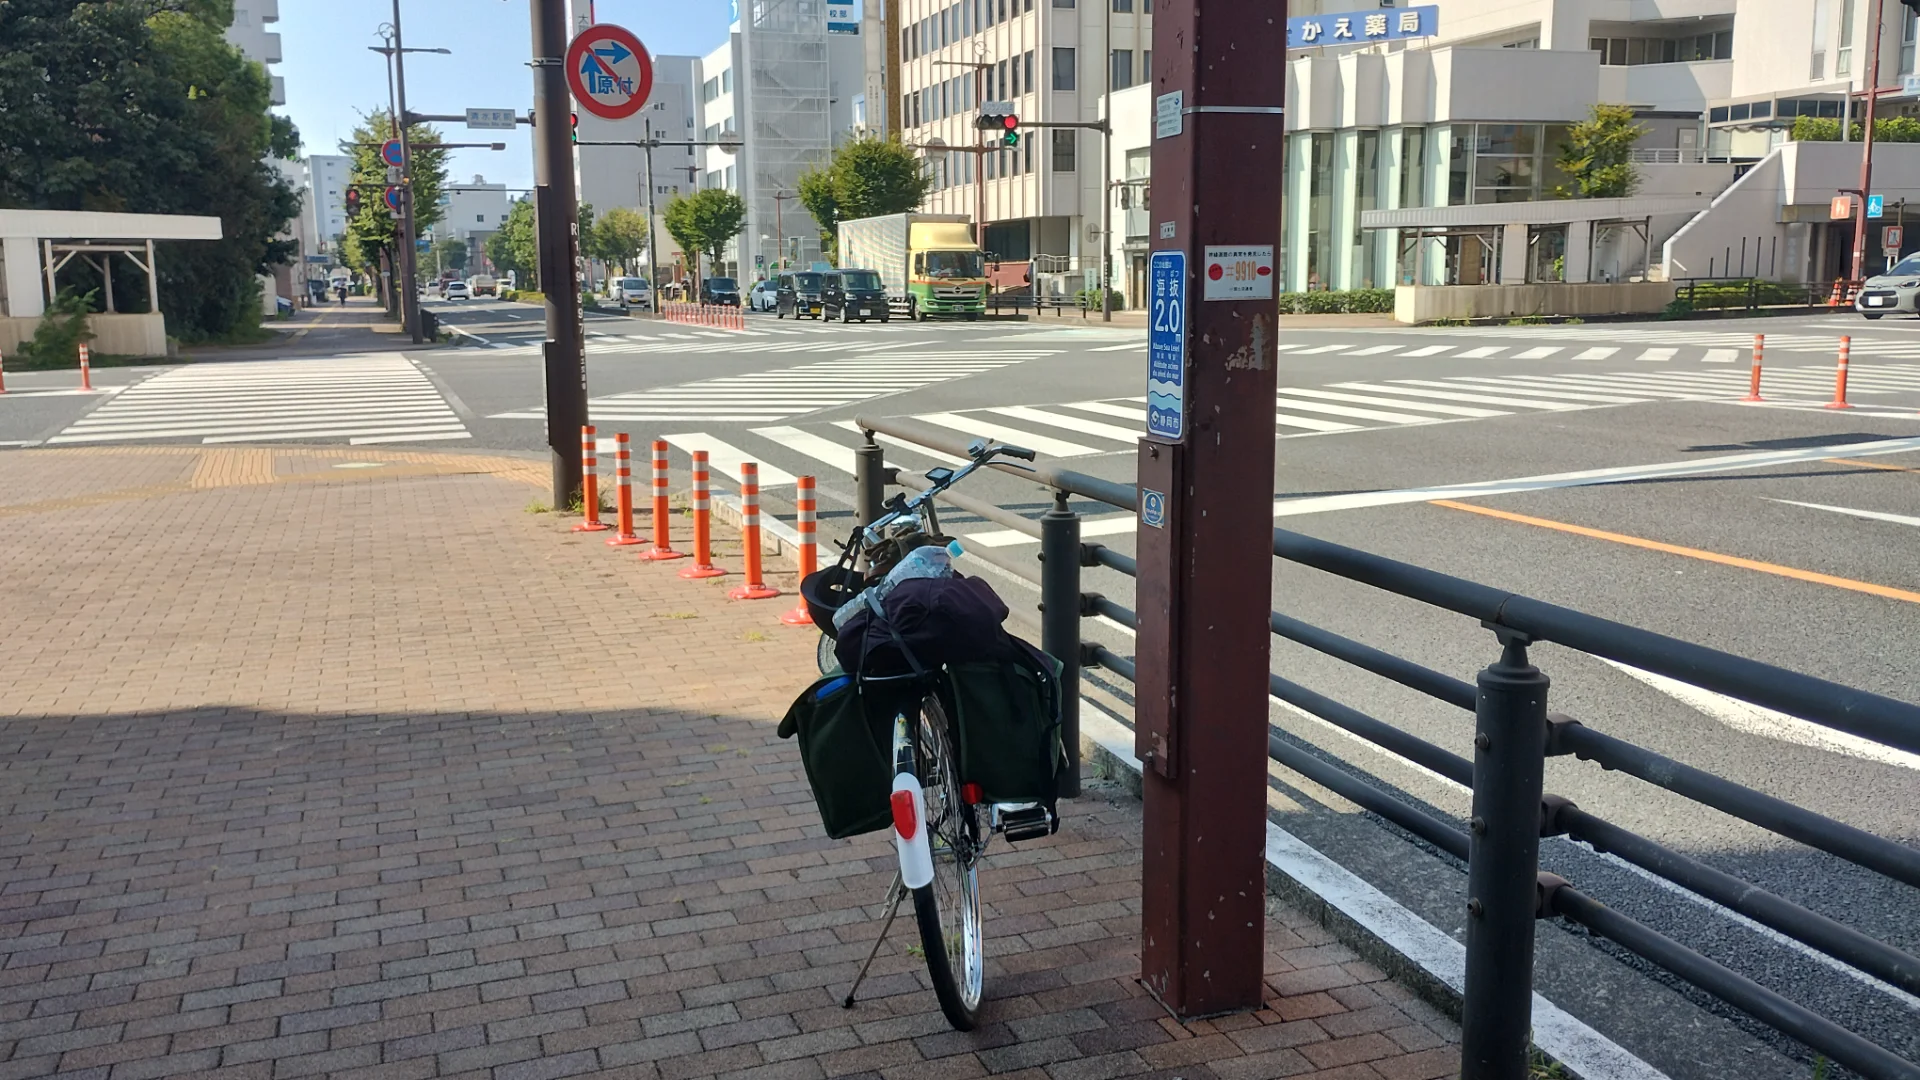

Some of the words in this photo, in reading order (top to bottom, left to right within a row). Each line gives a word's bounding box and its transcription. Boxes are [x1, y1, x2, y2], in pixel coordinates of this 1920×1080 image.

[1286, 11, 1420, 42] かえ薬局
[597, 75, 634, 96] 原付
[1225, 260, 1257, 282] #9910
[1155, 278, 1180, 298] 海抜
[1154, 298, 1181, 333] 2.0
[1175, 334, 1181, 343] m
